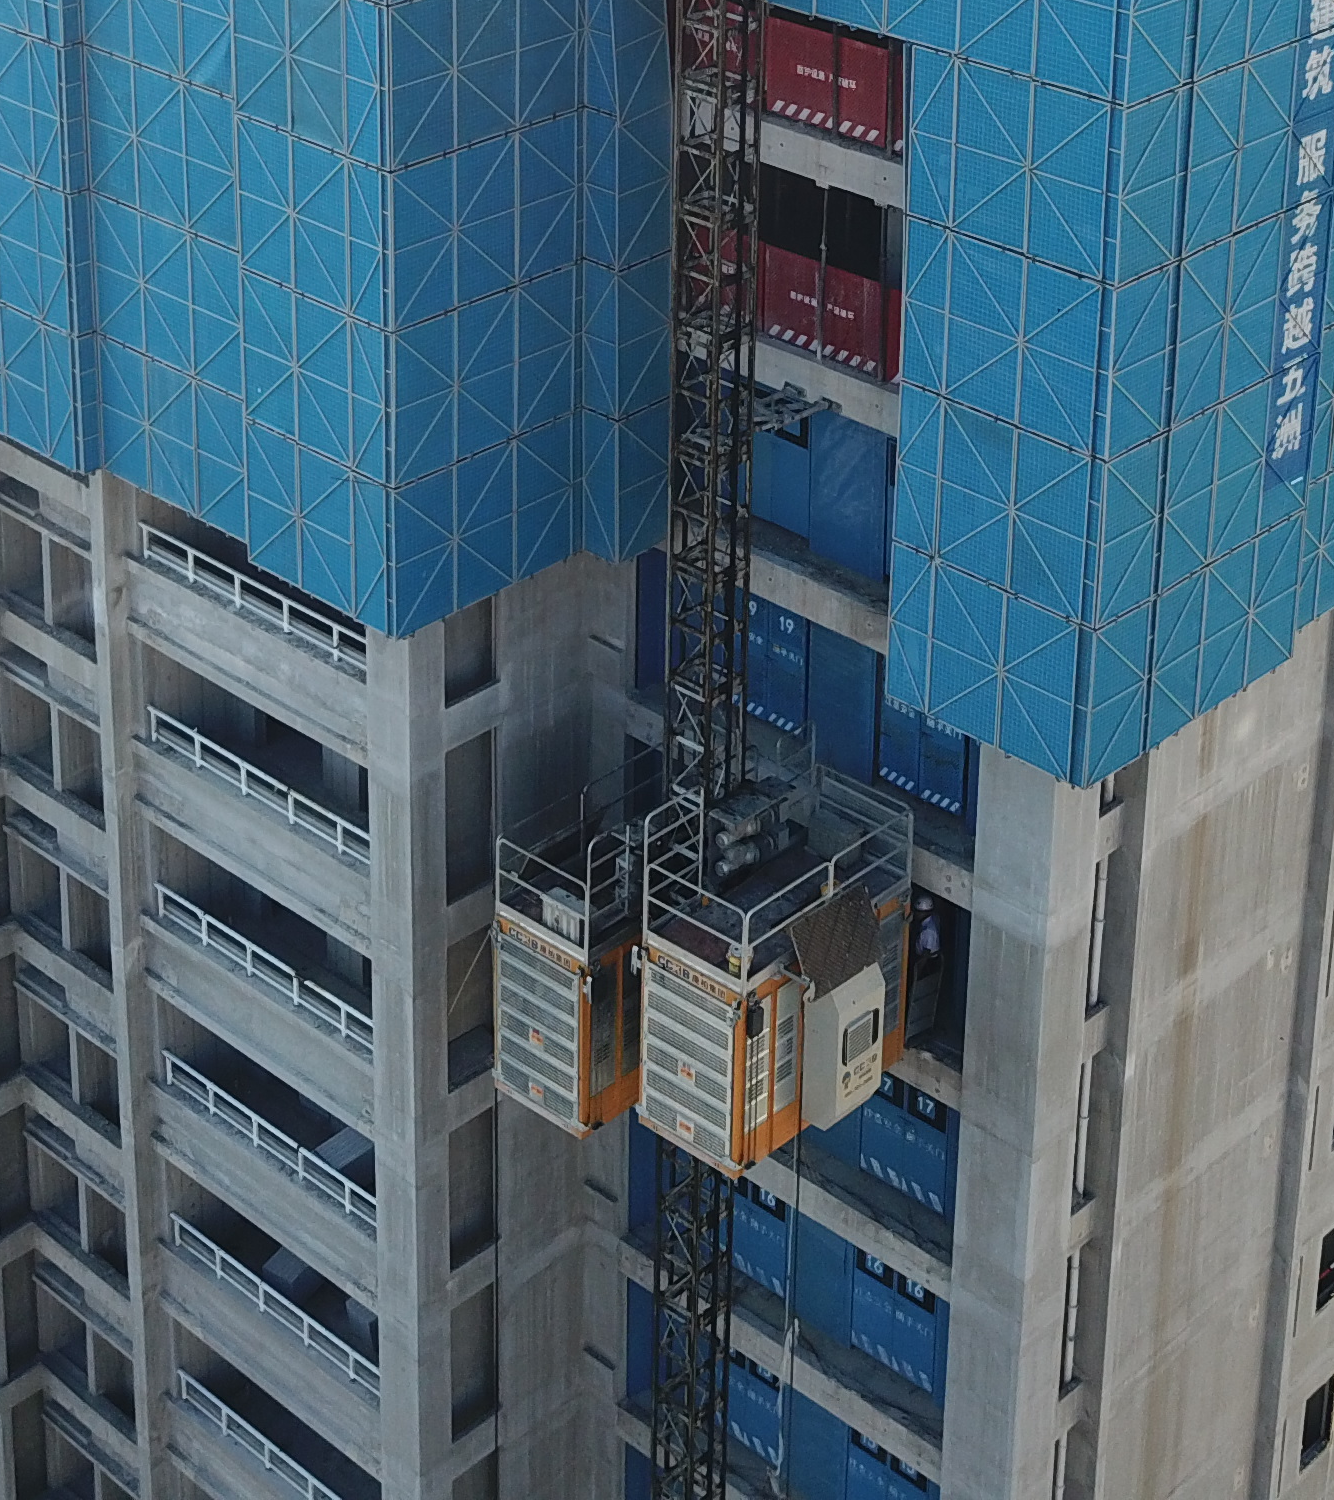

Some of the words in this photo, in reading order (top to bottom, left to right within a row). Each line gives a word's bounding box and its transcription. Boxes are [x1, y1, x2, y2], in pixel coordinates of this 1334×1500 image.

[1271, 128, 1328, 460] 服务跨越五洲
[779, 615, 795, 634] 19
[917, 1095, 936, 1115] 17
[759, 1188, 776, 1207] 16
[867, 1255, 884, 1275] 16
[906, 1278, 925, 1299] 16
